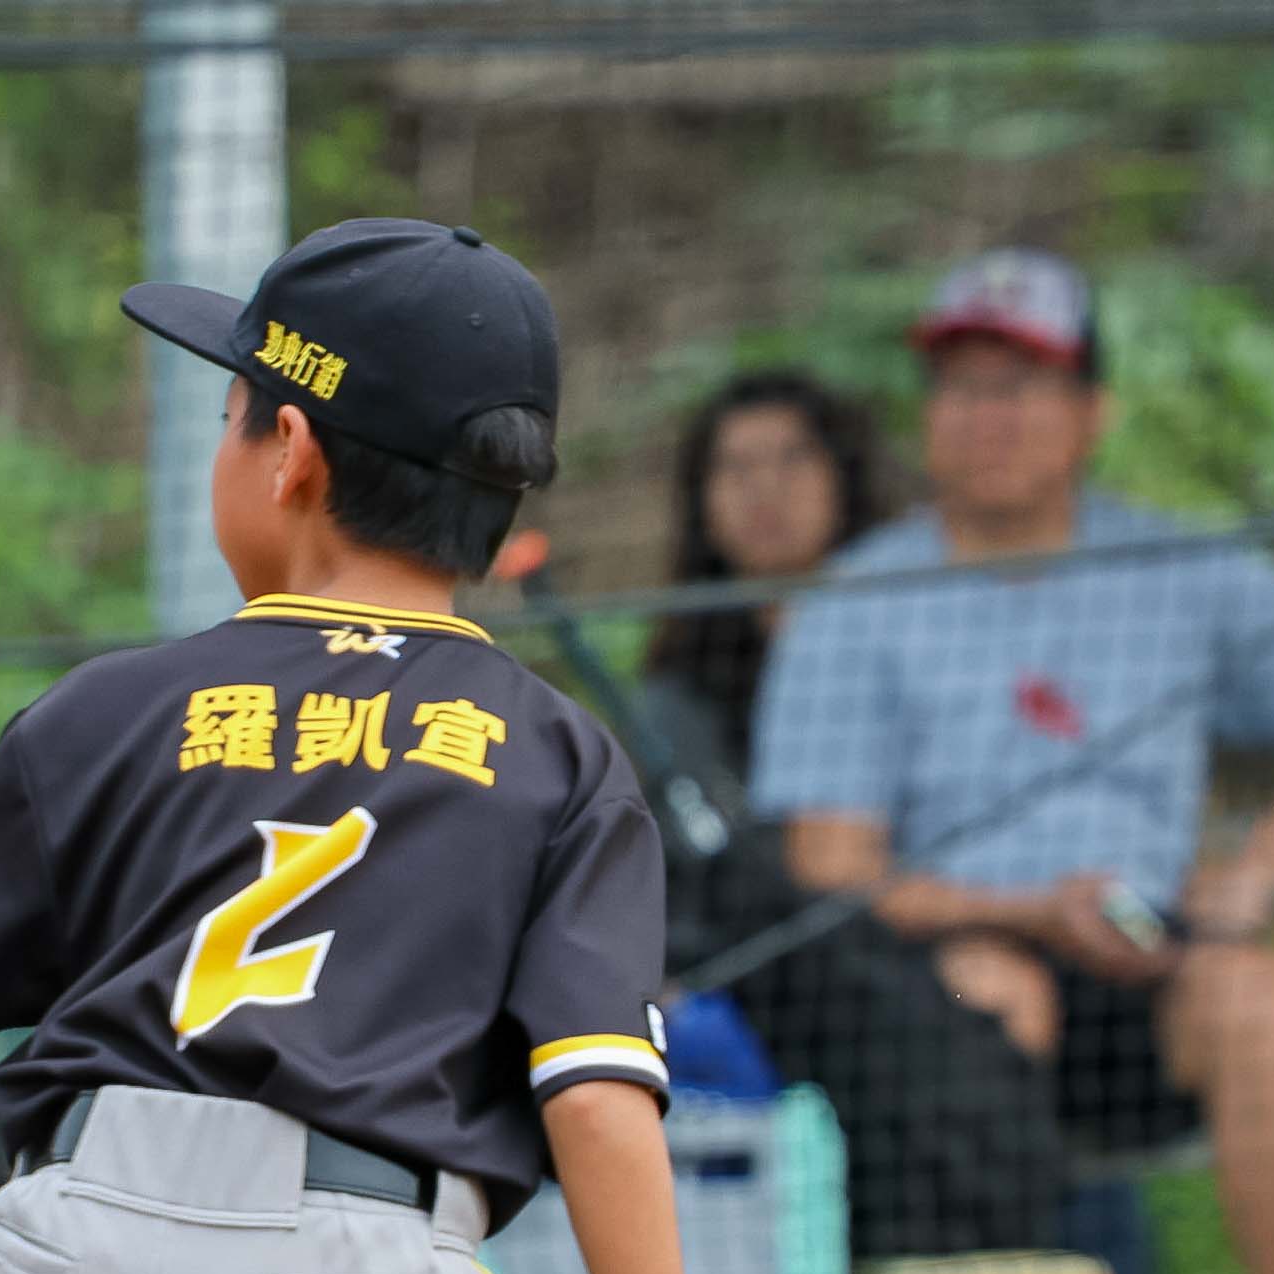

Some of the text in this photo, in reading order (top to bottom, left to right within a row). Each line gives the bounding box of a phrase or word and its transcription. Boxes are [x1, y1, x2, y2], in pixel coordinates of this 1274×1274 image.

[178, 684, 507, 787] 羅凱宣
[170, 805, 378, 1051] 2
